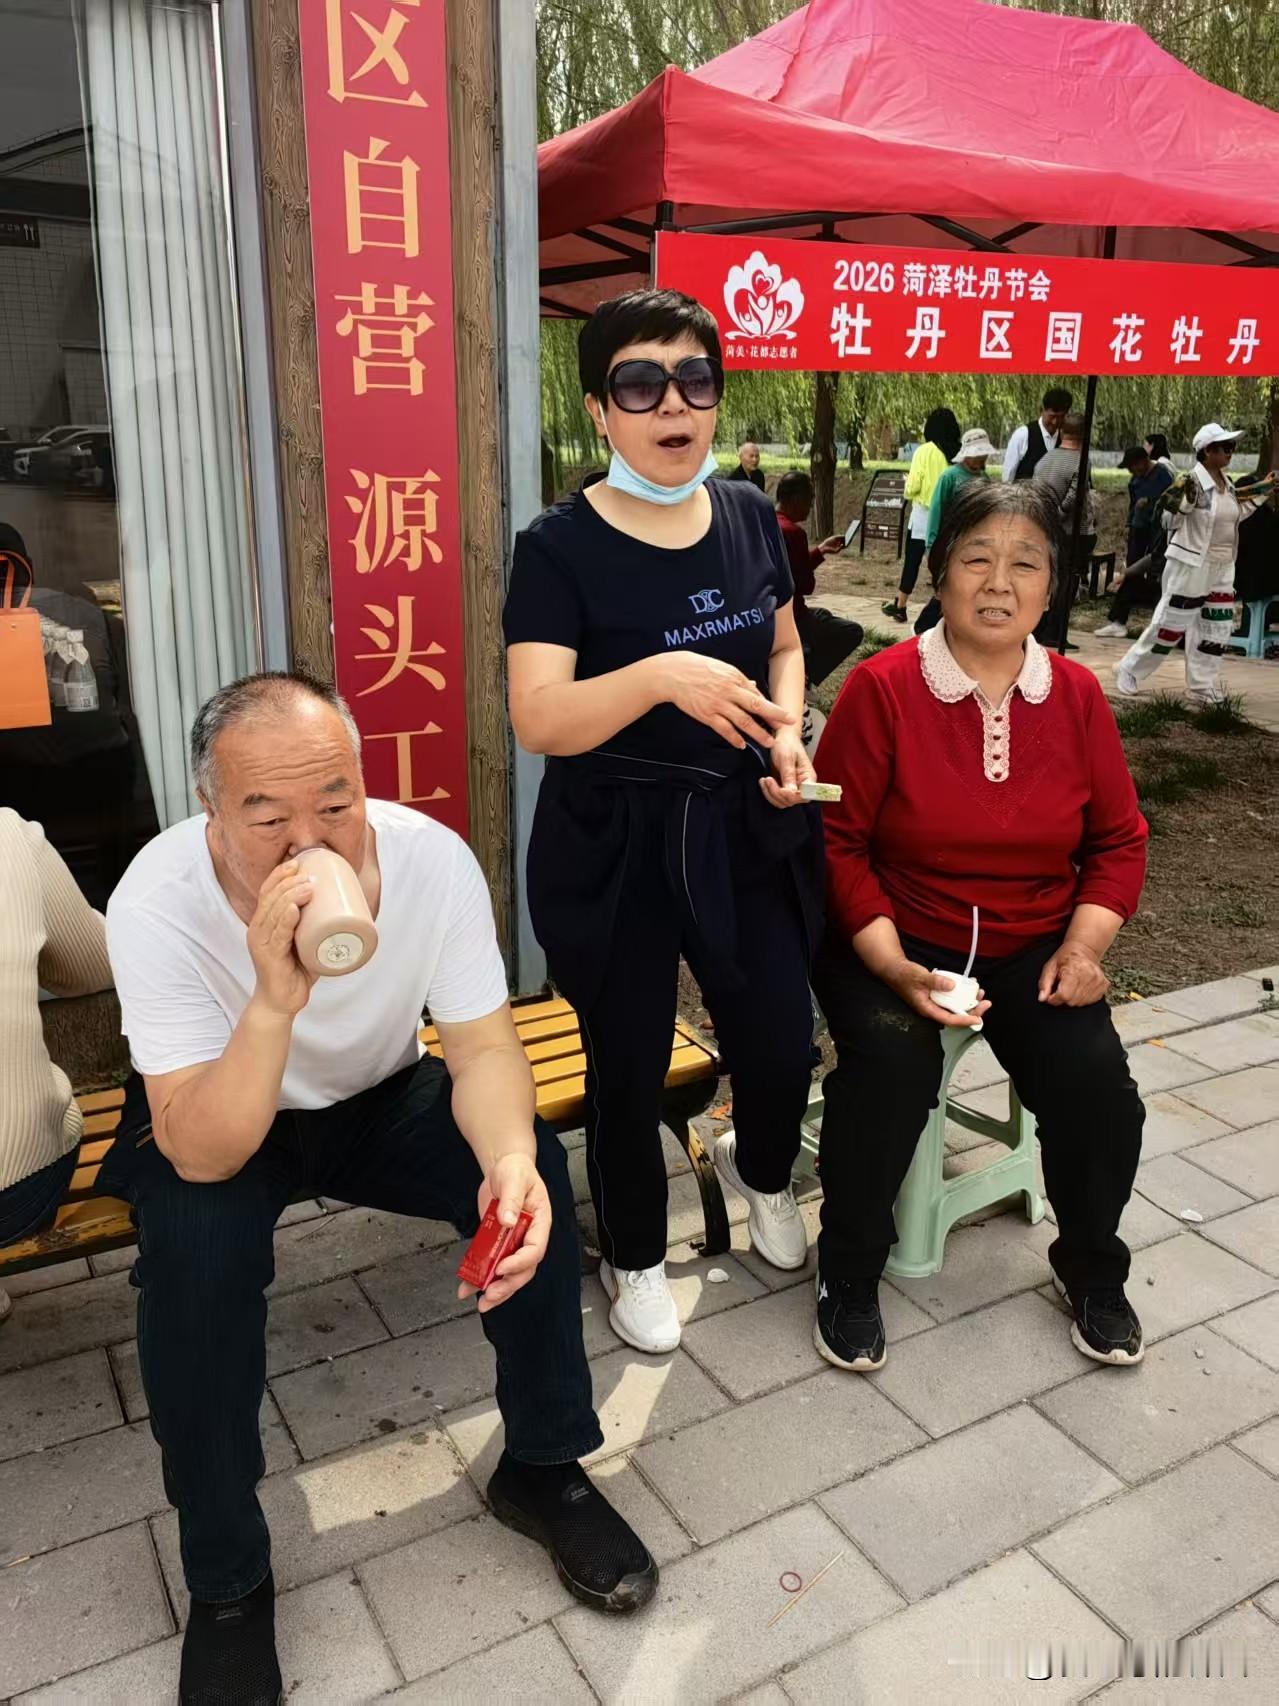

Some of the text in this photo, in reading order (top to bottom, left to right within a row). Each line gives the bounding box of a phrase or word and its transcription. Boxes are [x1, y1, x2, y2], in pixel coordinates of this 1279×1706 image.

[833, 259, 1052, 302] 2026 菏泽牡丹节会
[829, 302, 1261, 365] 牡丹区国花牡丹
[325, 0, 452, 804] 区自营 源头工
